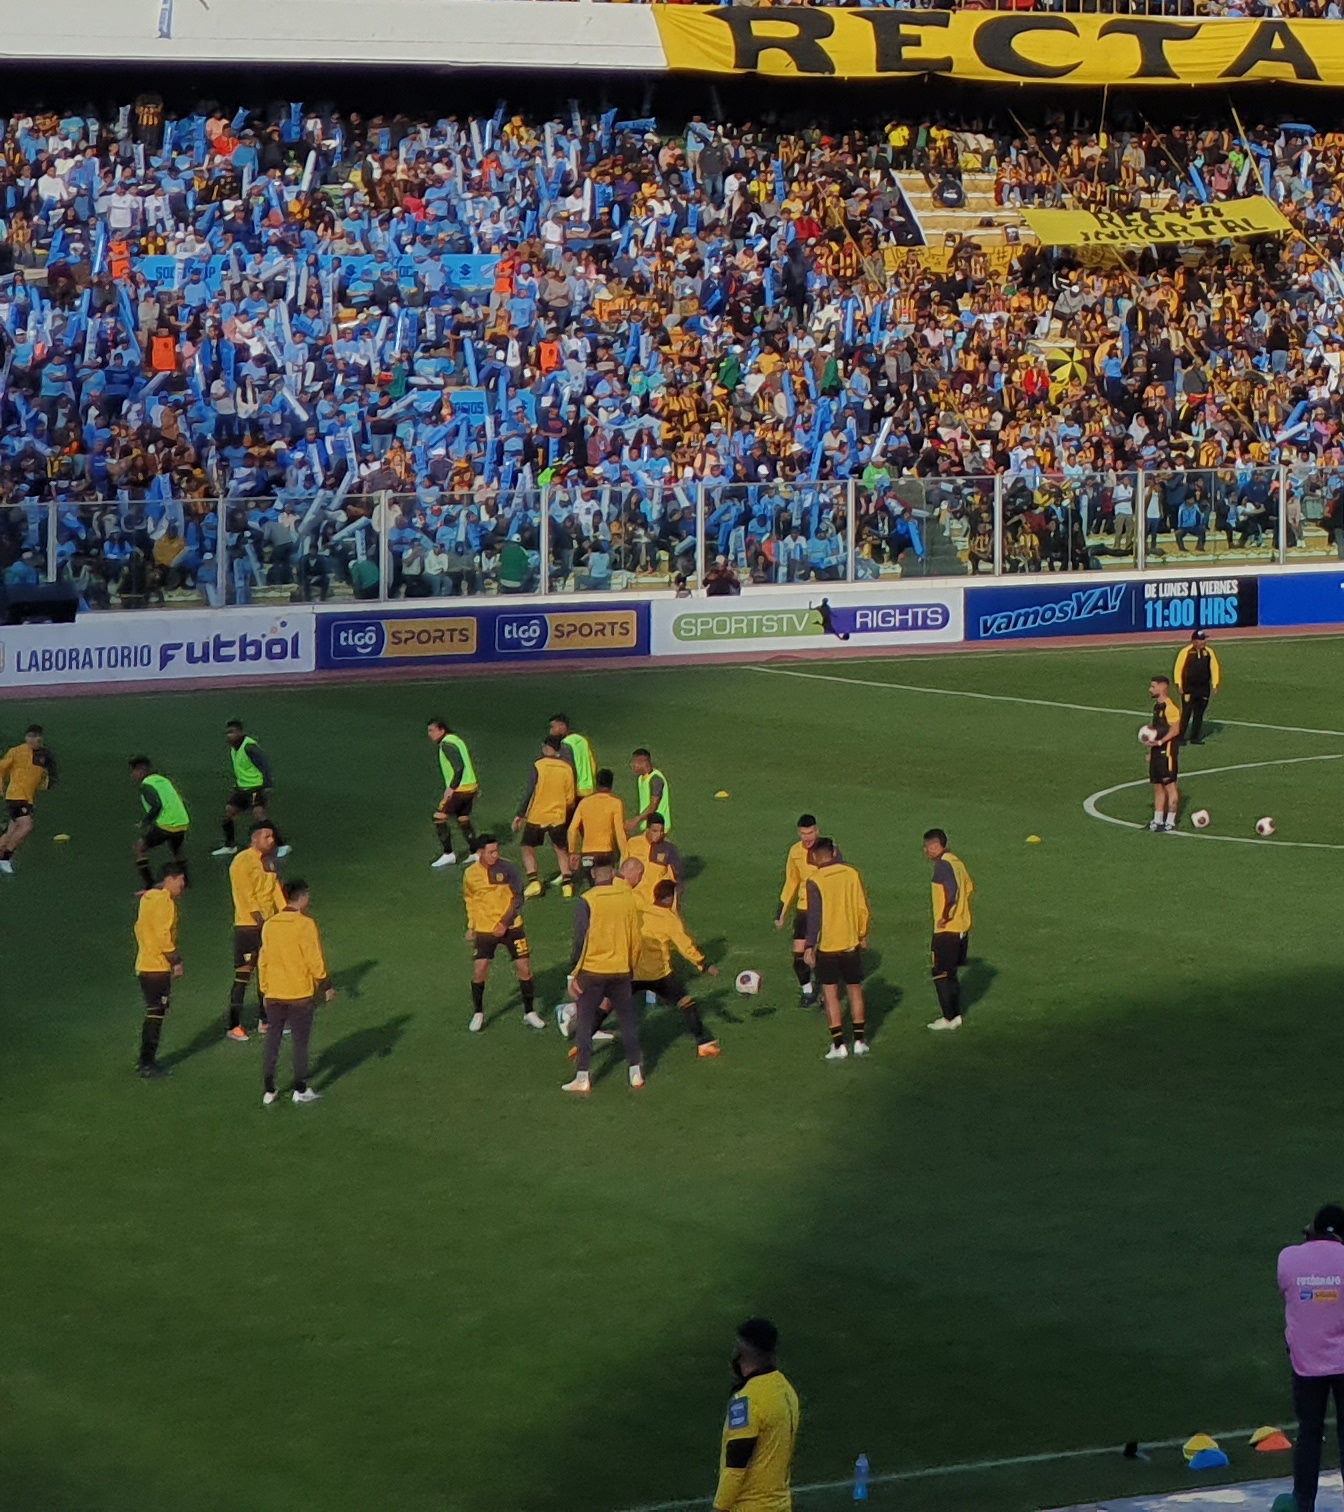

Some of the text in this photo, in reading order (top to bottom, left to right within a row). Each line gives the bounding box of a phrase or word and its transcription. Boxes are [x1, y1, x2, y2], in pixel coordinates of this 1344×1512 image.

[705, 5, 1322, 81] RECTA
[1144, 579, 1239, 598] DE LUNES A VIERNES
[679, 607, 944, 637] SPORTSTV RIGHTS
[1144, 596, 1239, 629] 11:00 HRS
[390, 626, 470, 646] SPORTS
[553, 621, 630, 639] SPORTS
[16, 644, 151, 673] LABORATORIO
